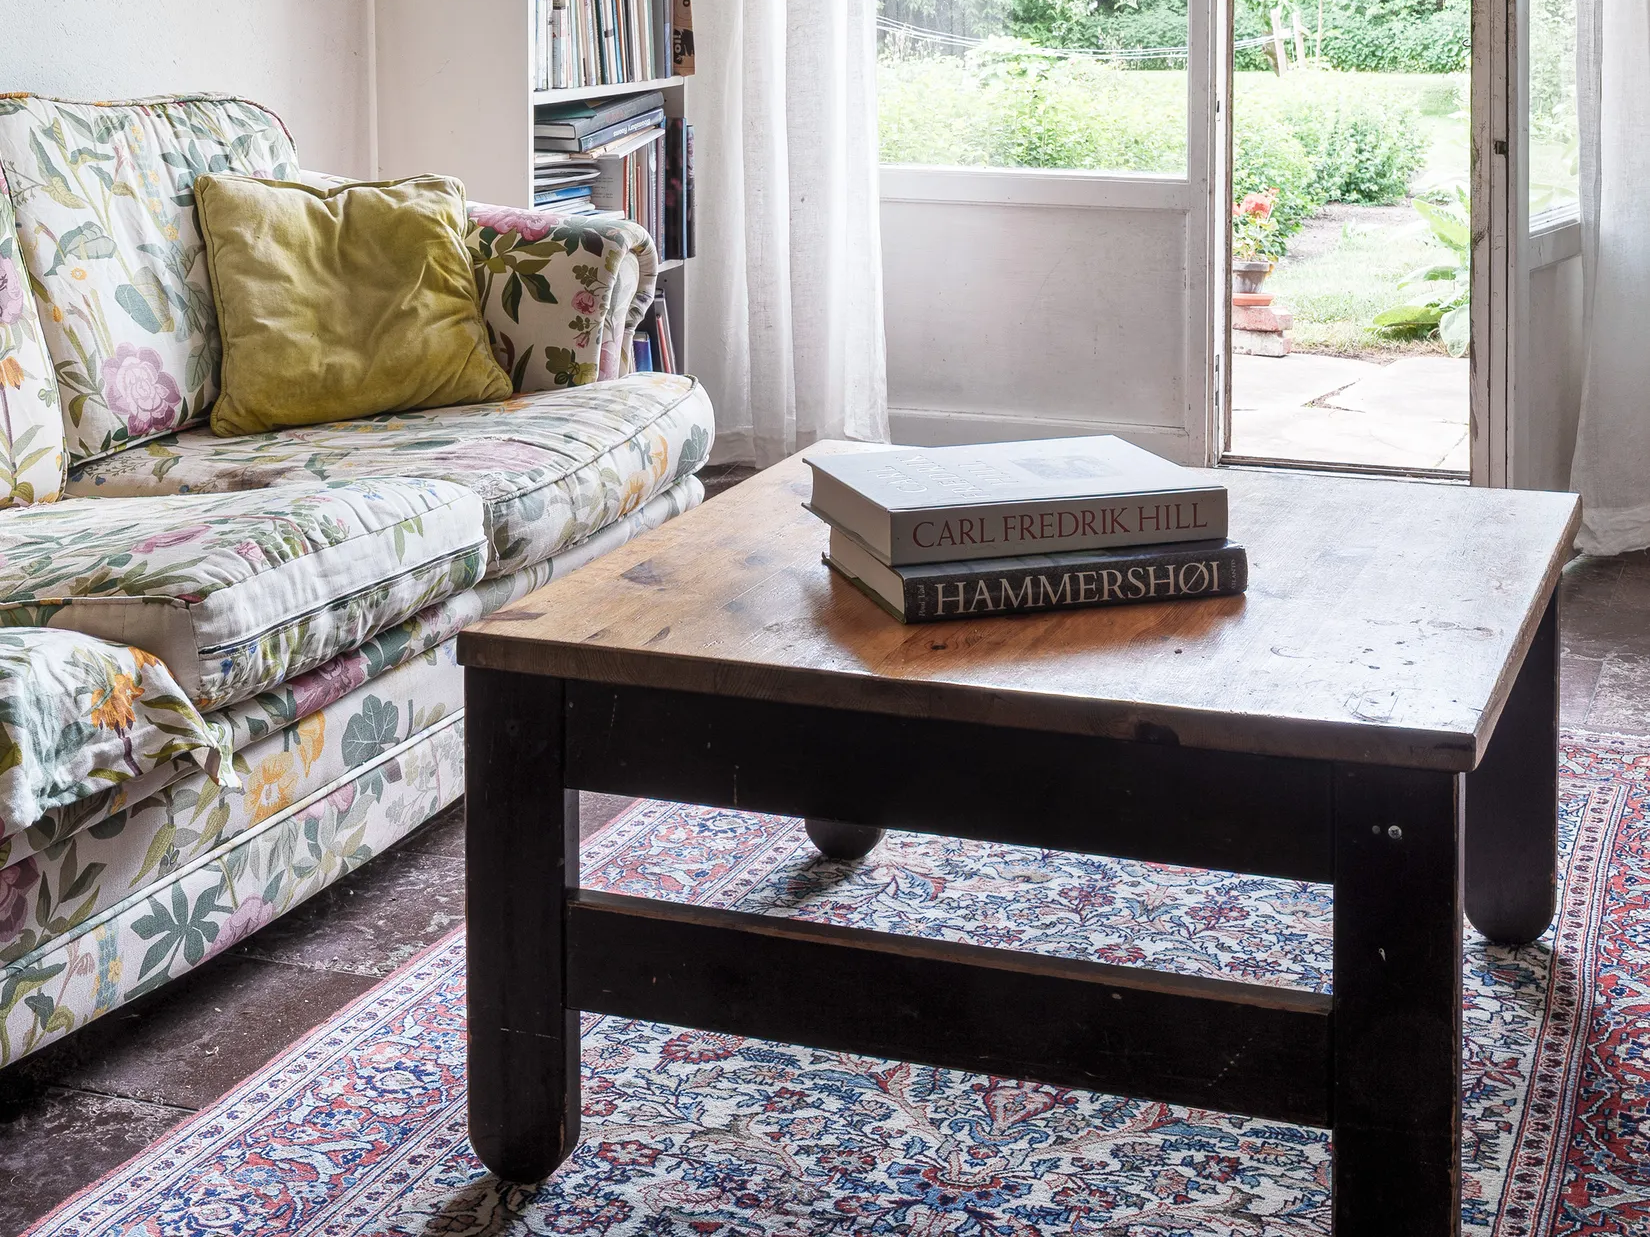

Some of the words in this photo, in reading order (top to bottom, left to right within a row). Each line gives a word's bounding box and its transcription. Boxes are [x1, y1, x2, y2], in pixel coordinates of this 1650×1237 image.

[866, 465, 928, 493] CARL
[912, 517, 996, 548] CARL
[1002, 506, 1131, 542] FREDRIK
[1137, 502, 1208, 533] HILL
[933, 560, 1220, 616] HAMMERSHØI
[1230, 559, 1238, 590] ATLANTIS
